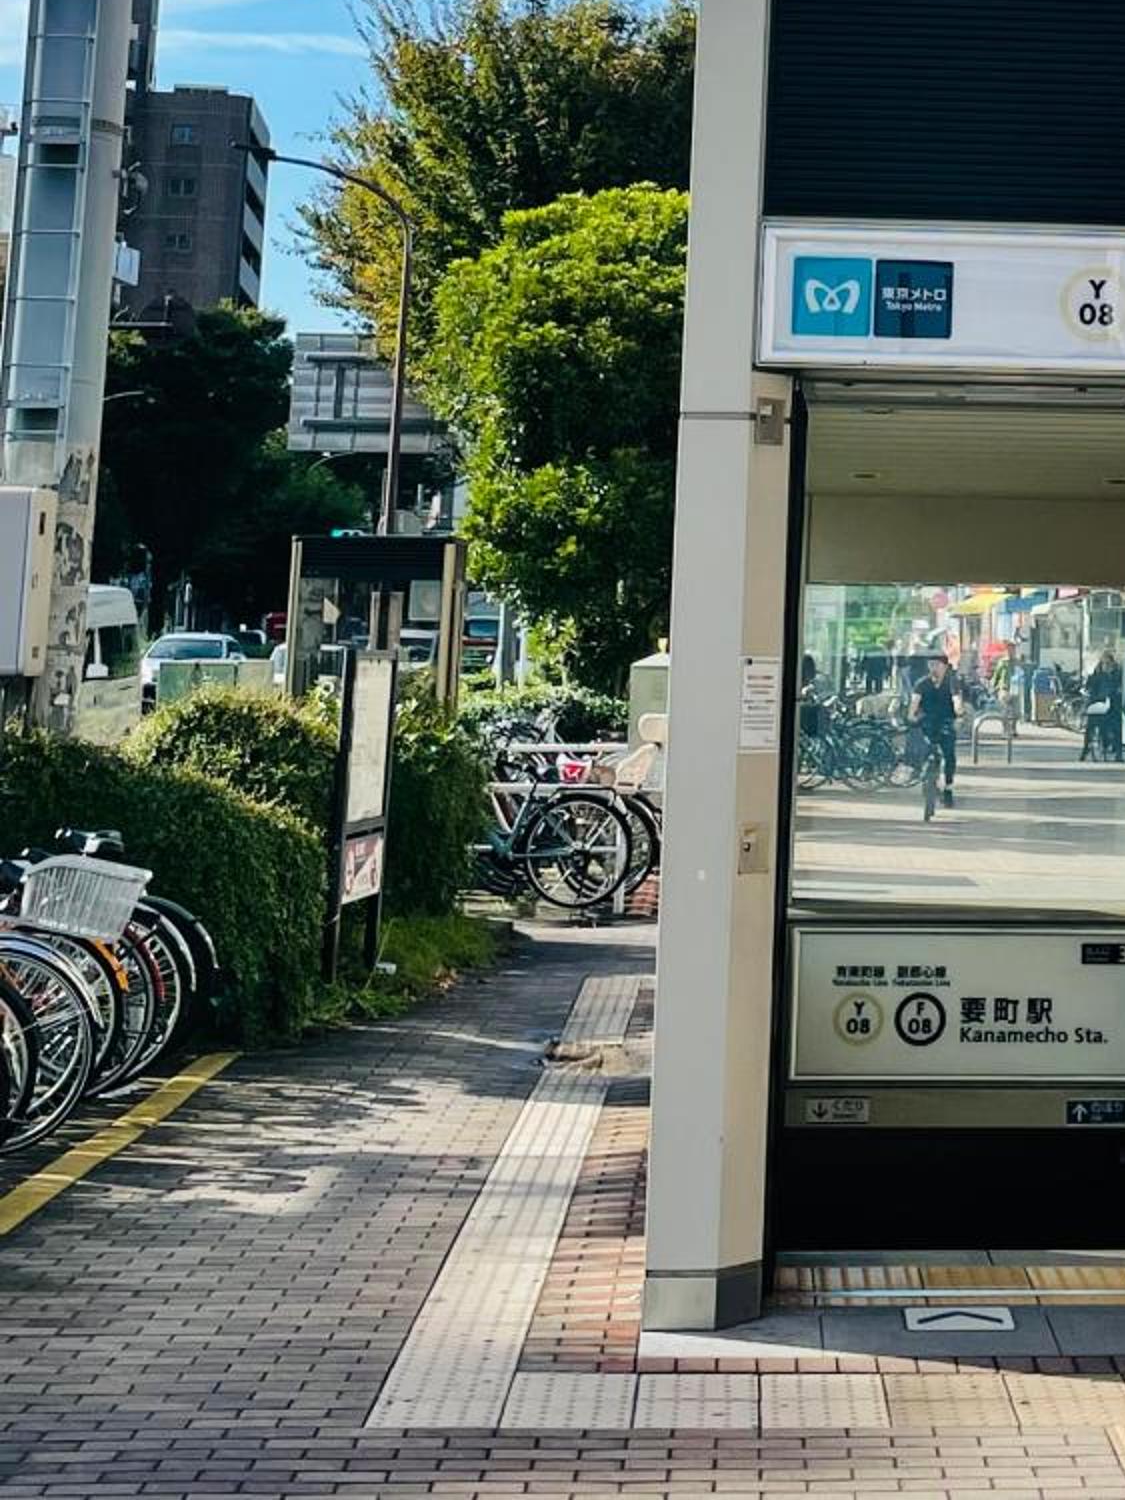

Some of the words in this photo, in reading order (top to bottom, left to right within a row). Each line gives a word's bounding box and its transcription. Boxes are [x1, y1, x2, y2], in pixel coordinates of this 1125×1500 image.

[881, 286, 947, 301] 東京メトロ
[1088, 279, 1106, 299] Y
[885, 301, 912, 313] Tokyo
[914, 302, 943, 312] Metro
[1079, 303, 1114, 326] 08
[854, 1002, 865, 1016] Y
[916, 1002, 925, 1016] F
[960, 997, 1053, 1025] 要町駅
[846, 1018, 871, 1035] 08
[908, 1018, 932, 1035] 08
[959, 1027, 1069, 1044] Kanamecho
[1075, 1028, 1108, 1044] Sta.
